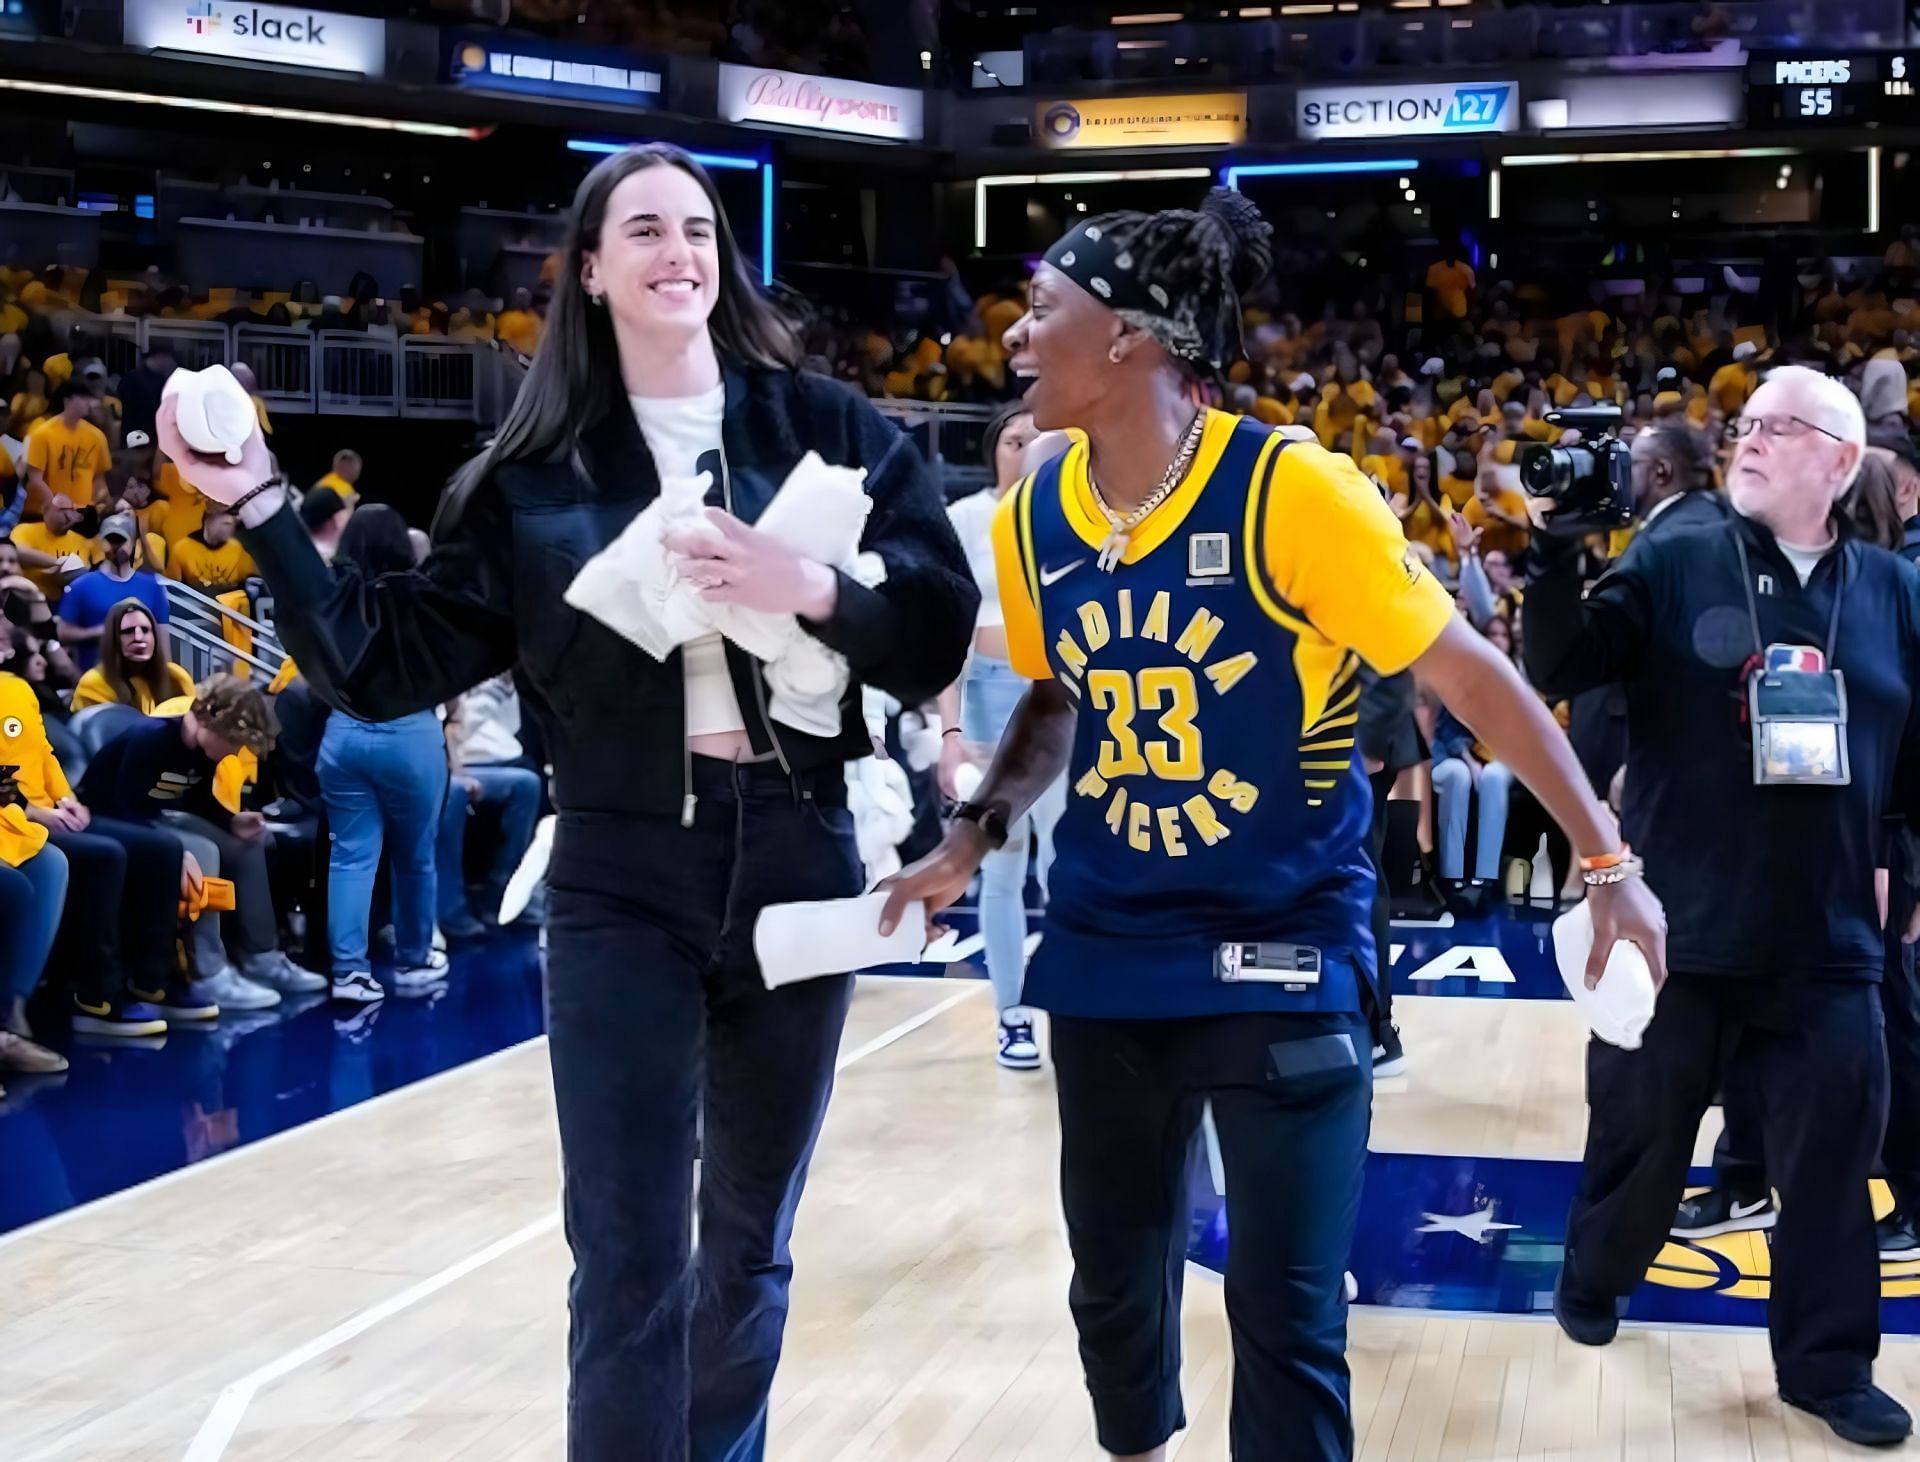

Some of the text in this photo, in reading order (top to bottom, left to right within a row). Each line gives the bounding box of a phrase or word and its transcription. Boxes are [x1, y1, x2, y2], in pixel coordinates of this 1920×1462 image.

[233, 9, 326, 45] slack
[1304, 94, 1496, 125] SECTION 127
[1800, 88, 1832, 115] 55
[1088, 666, 1204, 781] 33
[1074, 766, 1259, 857] PACERS
